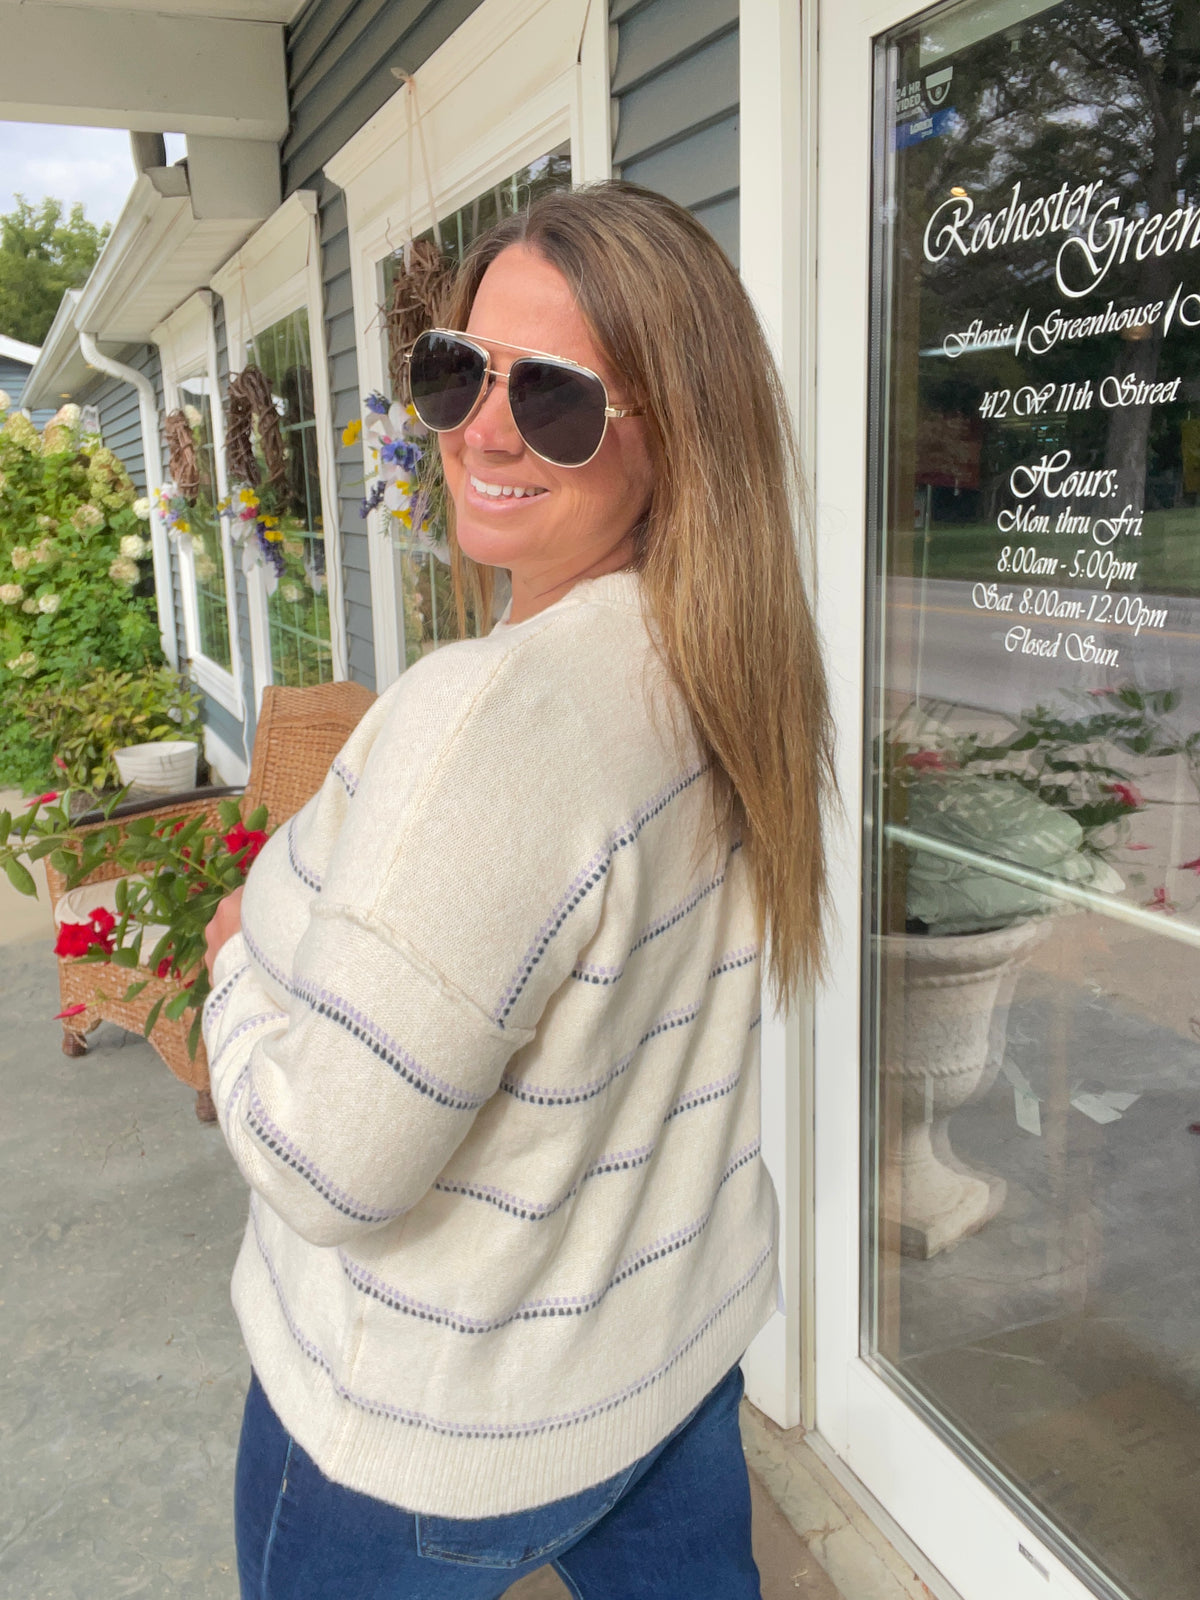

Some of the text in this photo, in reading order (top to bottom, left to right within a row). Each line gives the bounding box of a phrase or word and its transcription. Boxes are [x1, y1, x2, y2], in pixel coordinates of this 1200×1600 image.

[923, 180, 1103, 263] Rochester
[978, 373, 1182, 419] 412 W. 11th Street
[1009, 449, 1119, 499] Hours:
[997, 504, 1144, 546] Mon. thru Fri.
[997, 546, 1058, 575] 8:00am
[1068, 549, 1138, 590] 5:00pm
[972, 583, 1014, 612] Sat.
[1004, 625, 1120, 668] Closed Sun.
